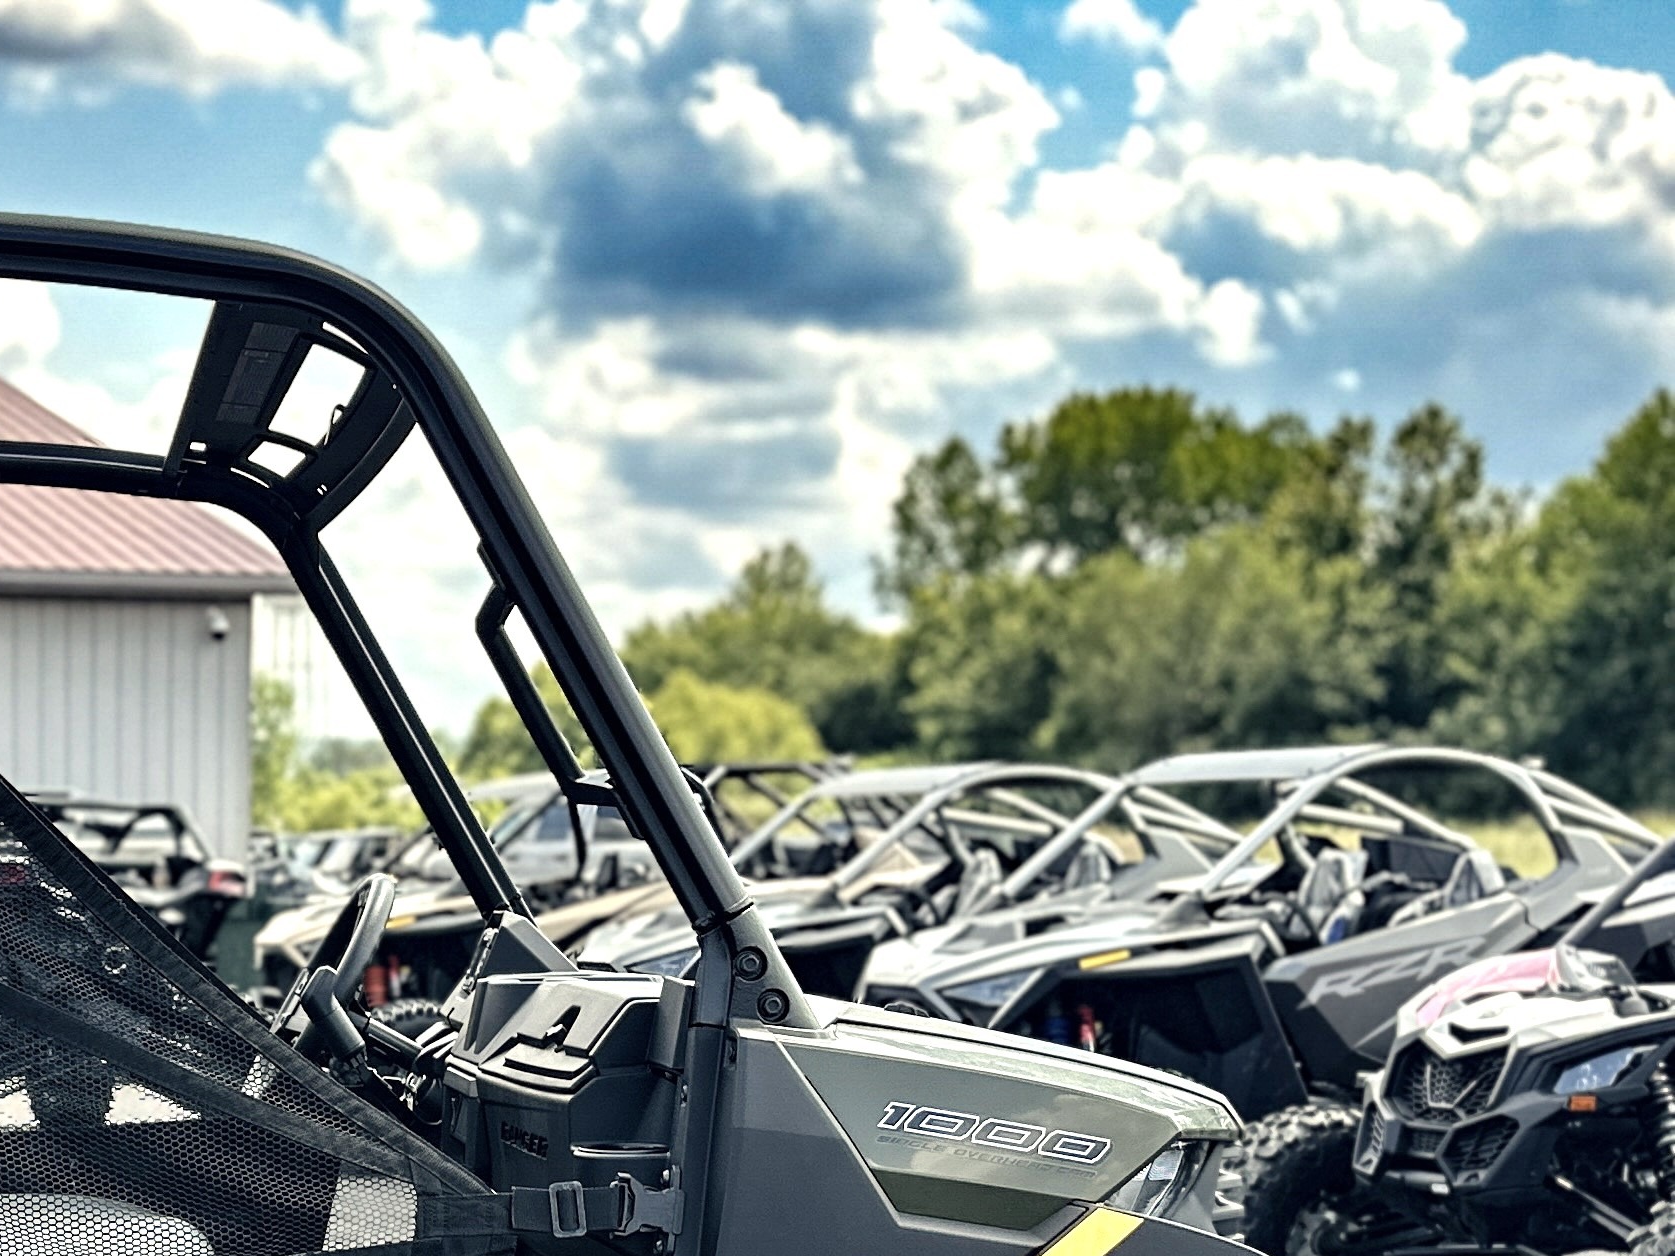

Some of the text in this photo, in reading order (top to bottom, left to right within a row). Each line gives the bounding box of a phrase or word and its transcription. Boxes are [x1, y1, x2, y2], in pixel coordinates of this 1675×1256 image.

[876, 1135, 945, 1152] SINGLE
[954, 1147, 1051, 1172] OVERHEAD
[877, 1102, 1110, 1164] 1000
